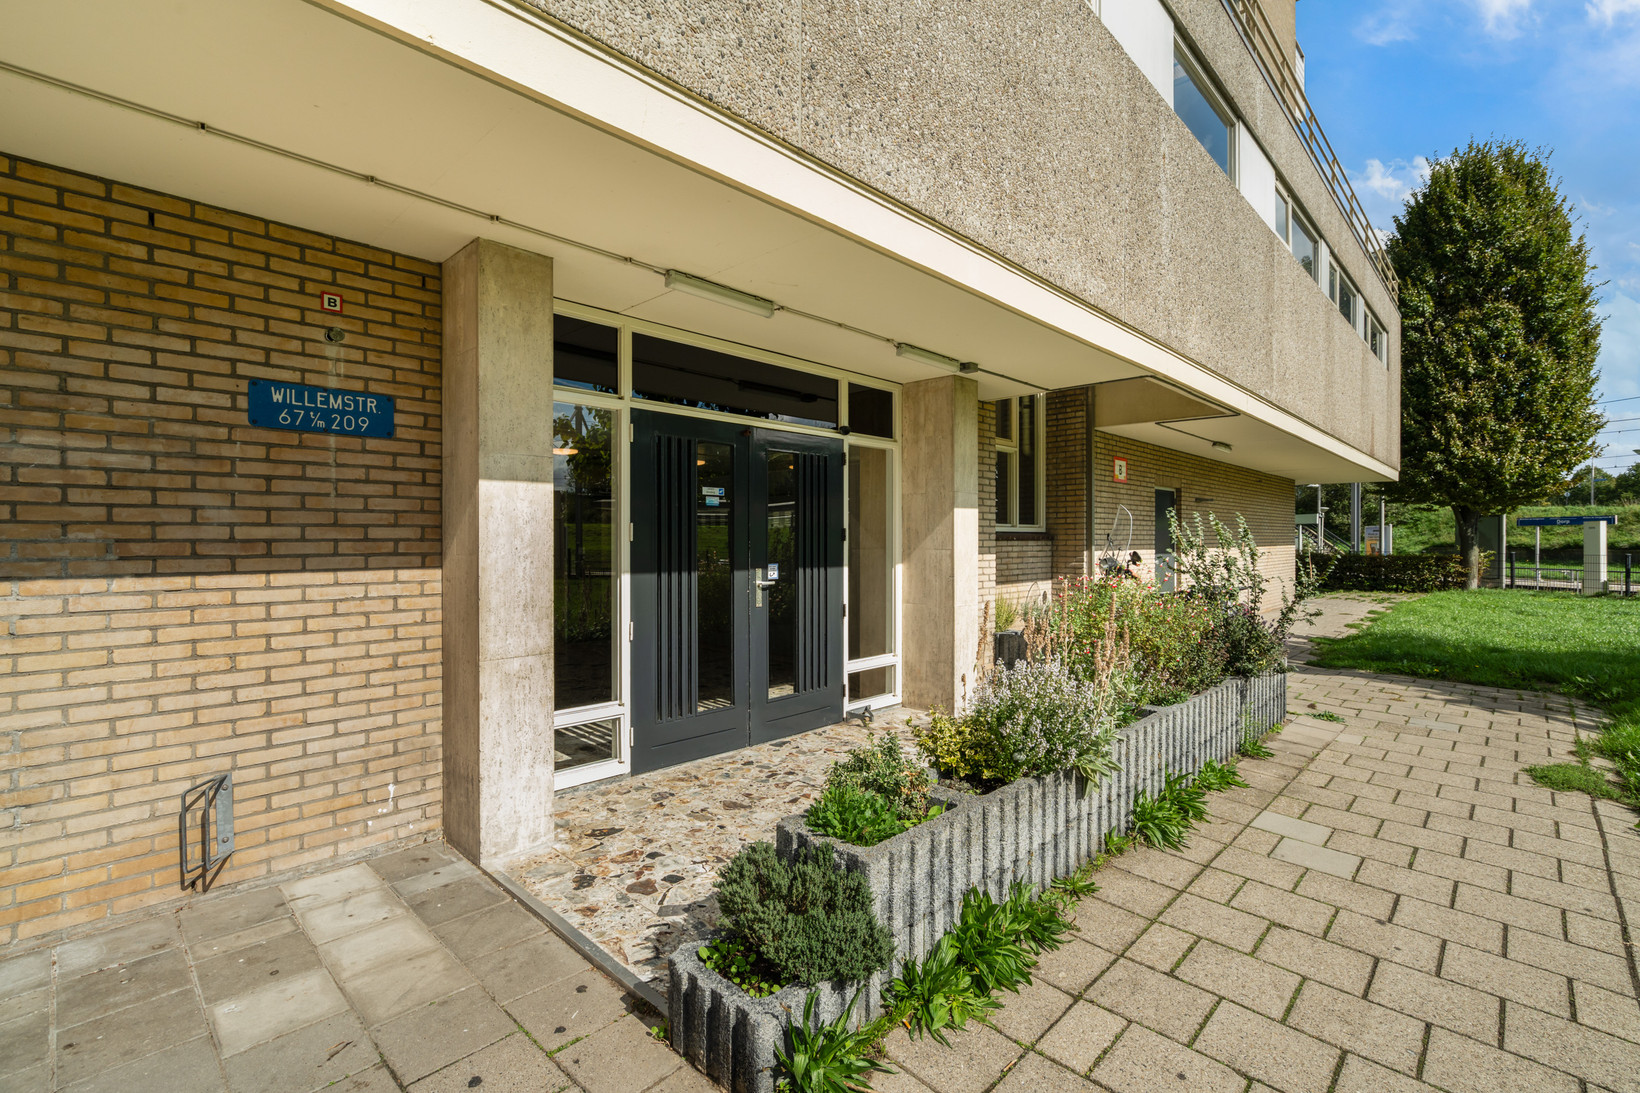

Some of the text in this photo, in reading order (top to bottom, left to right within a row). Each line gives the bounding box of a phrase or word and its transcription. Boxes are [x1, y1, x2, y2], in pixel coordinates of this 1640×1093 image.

[327, 297, 338, 308] B
[271, 386, 382, 414] WILLEMSTR.
[279, 409, 304, 426] 67
[331, 414, 369, 432] 209
